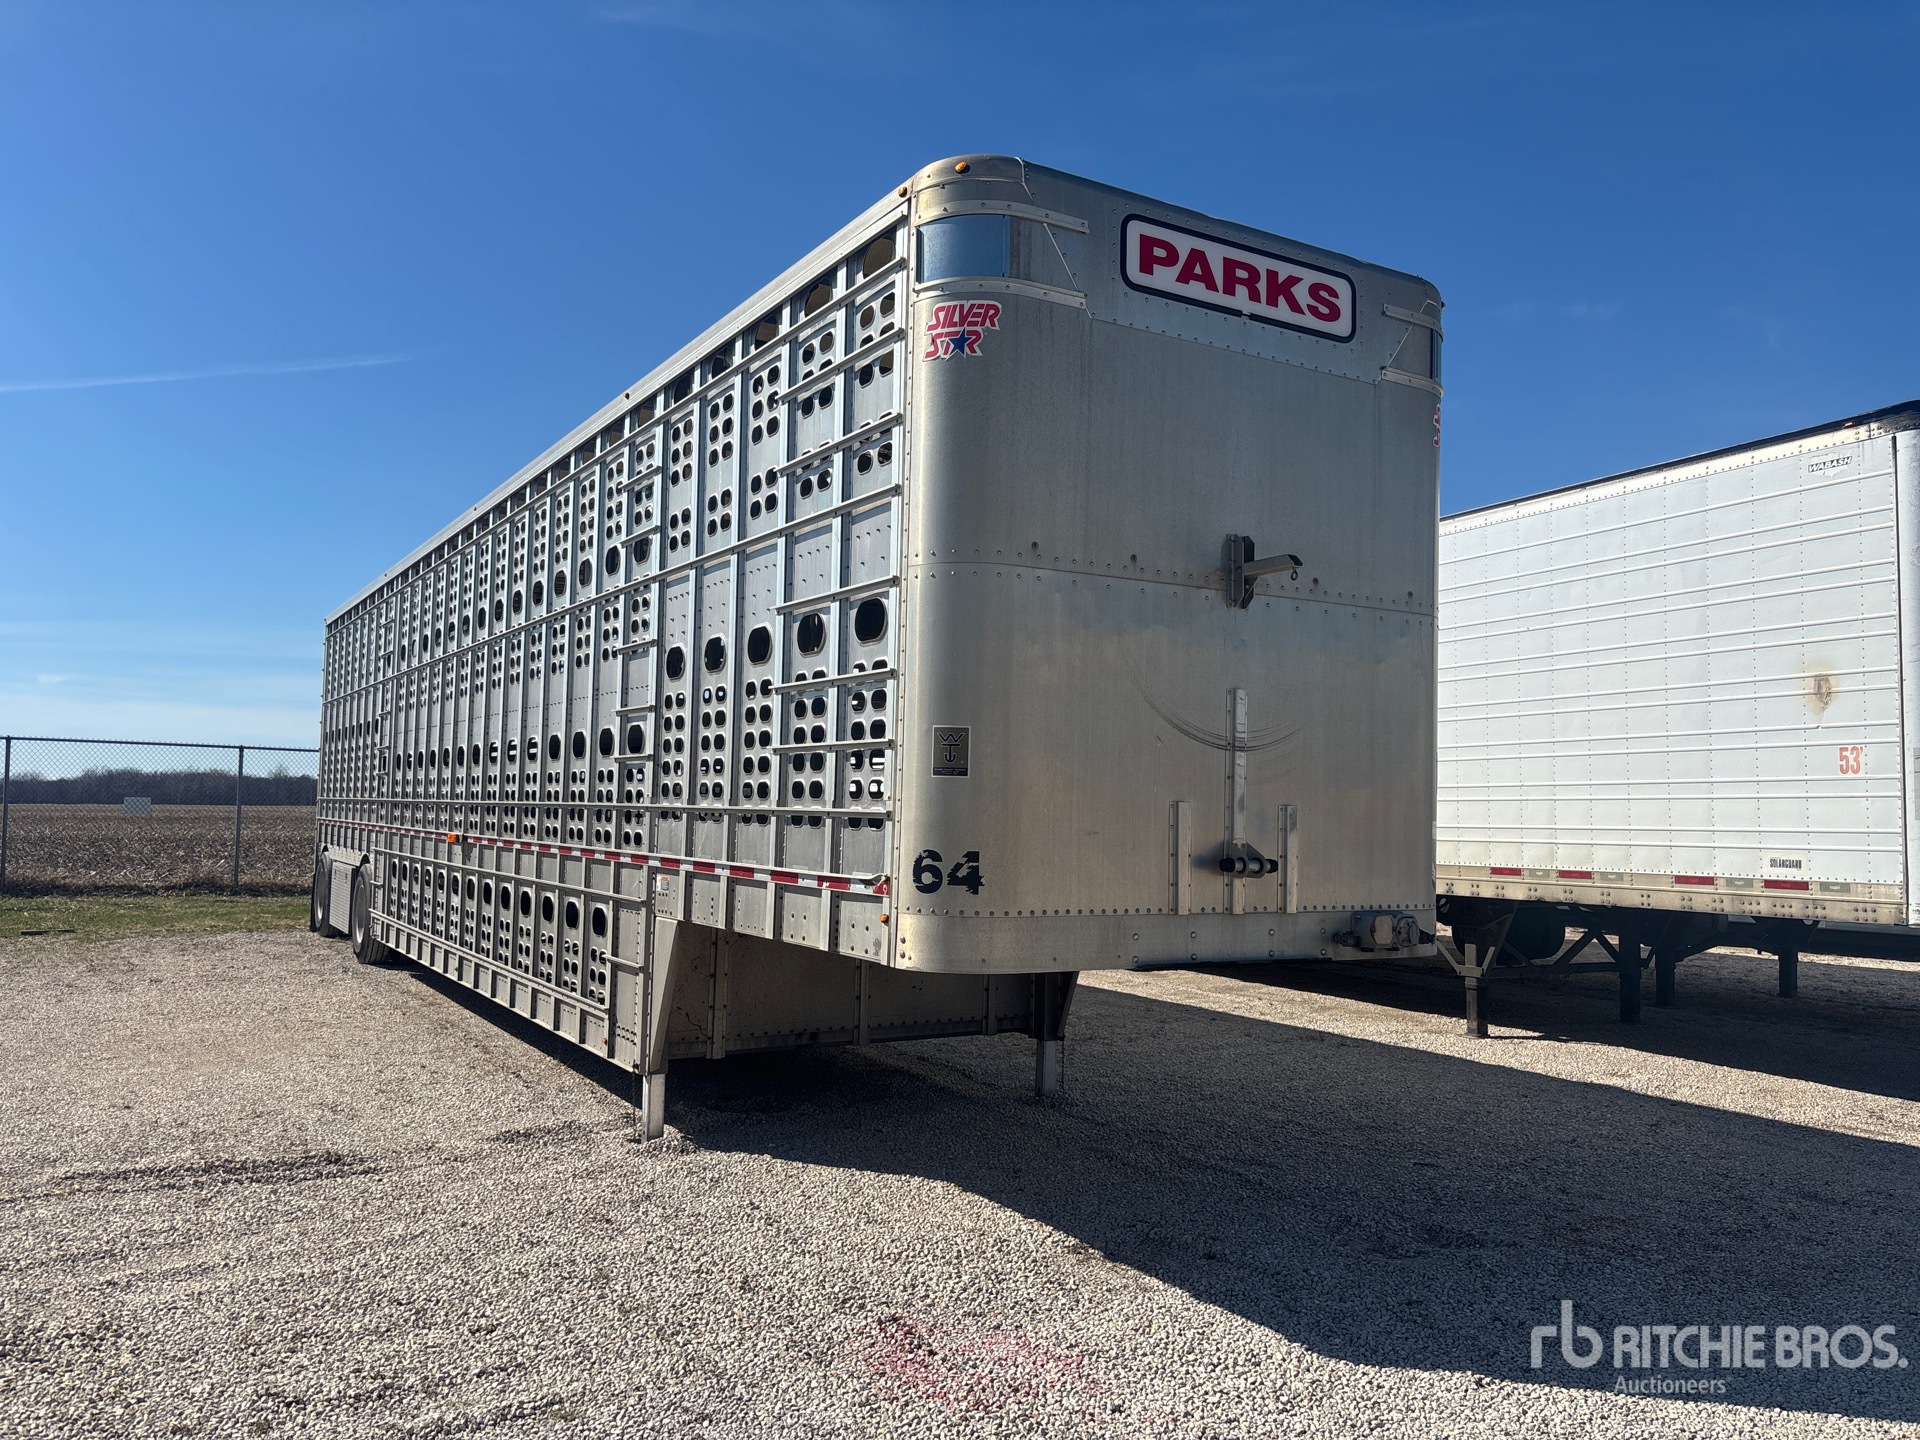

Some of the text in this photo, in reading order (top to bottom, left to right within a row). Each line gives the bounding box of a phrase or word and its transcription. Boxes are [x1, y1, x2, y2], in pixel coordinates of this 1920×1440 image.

[1139, 233, 1342, 323] PARKS
[927, 303, 1000, 331] SILVER
[1809, 456, 1852, 472] WABASH
[912, 849, 985, 895] 64
